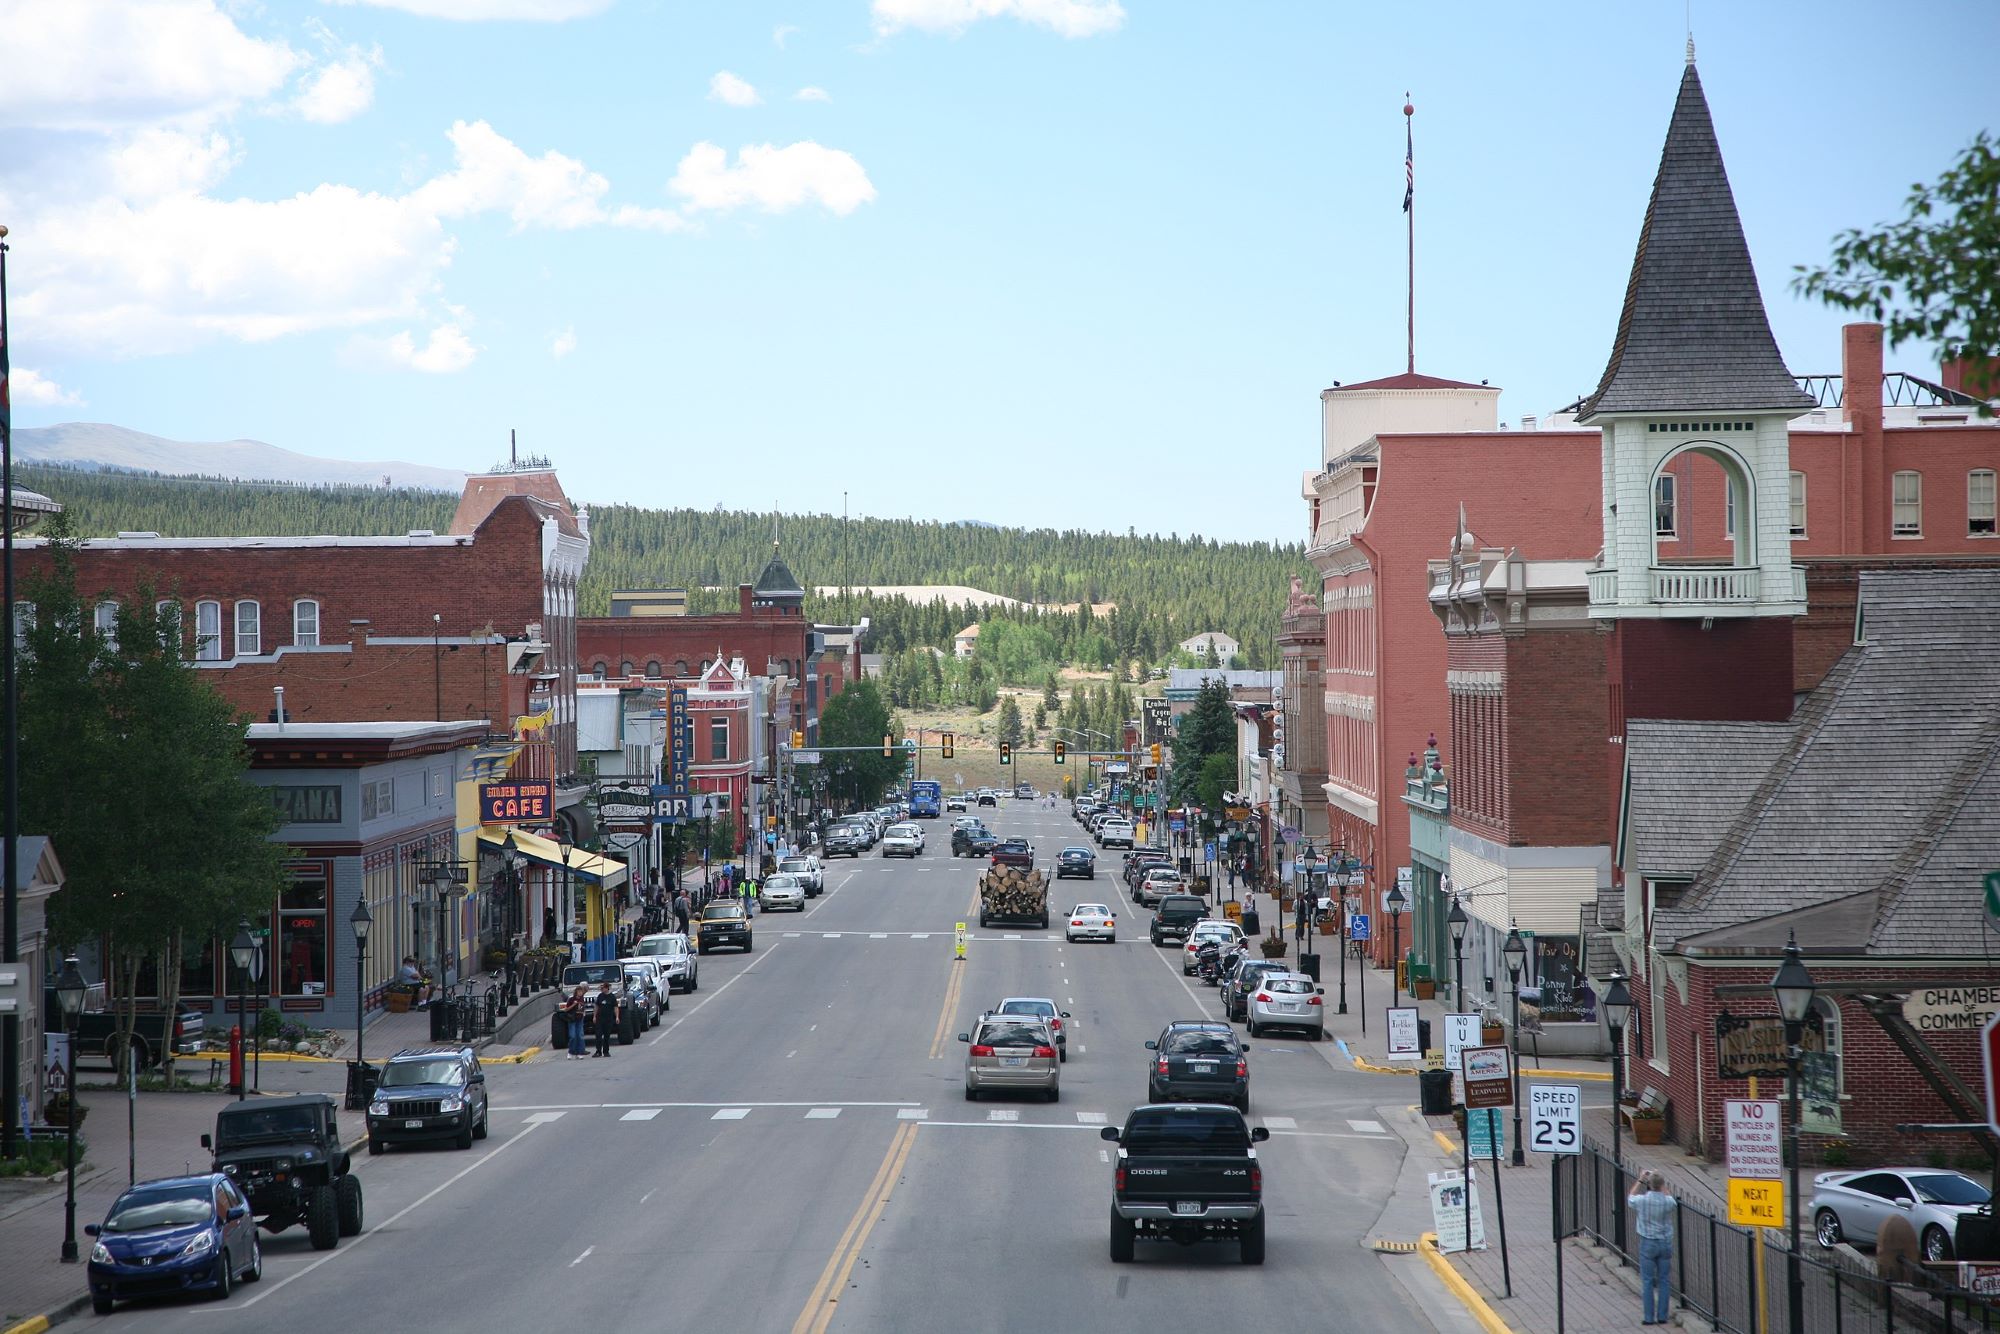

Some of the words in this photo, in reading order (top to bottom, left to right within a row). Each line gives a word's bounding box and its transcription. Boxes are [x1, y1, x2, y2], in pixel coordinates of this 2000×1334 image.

[673, 693, 684, 793] MANHATTAN
[274, 789, 339, 819] ZANA
[493, 799, 543, 818] CAFE
[292, 919, 315, 928] OPEN
[1563, 942, 1576, 959] Op
[1571, 974, 1589, 989] Lan
[1925, 988, 2000, 1006] CHAMBE
[1964, 1004, 1977, 1012] OF
[1456, 1017, 1468, 1026] NO
[1920, 1011, 1996, 1029] COMMER
[1458, 1029, 1466, 1042] U
[1725, 1027, 1813, 1052] VISITR
[1469, 1051, 1503, 1062] PRESERVE
[1724, 1053, 1787, 1065] INFORMA
[1472, 1088, 1506, 1096] LEADVILLE
[1533, 1092, 1576, 1104] SPEED
[1538, 1107, 1571, 1118] LIMIT
[1742, 1104, 1764, 1119] NO
[1731, 1122, 1761, 1130] BICYCLES
[1765, 1122, 1775, 1131] OR
[1535, 1120, 1576, 1146] 25
[1736, 1133, 1761, 1142] INLINES
[1762, 1133, 1773, 1142] OR
[1730, 1145, 1779, 1154] SKATEBOARDS
[1741, 1156, 1780, 1165] SIDEWALKS
[1743, 1189, 1769, 1201] NEXT
[1750, 1204, 1774, 1218] MILE
